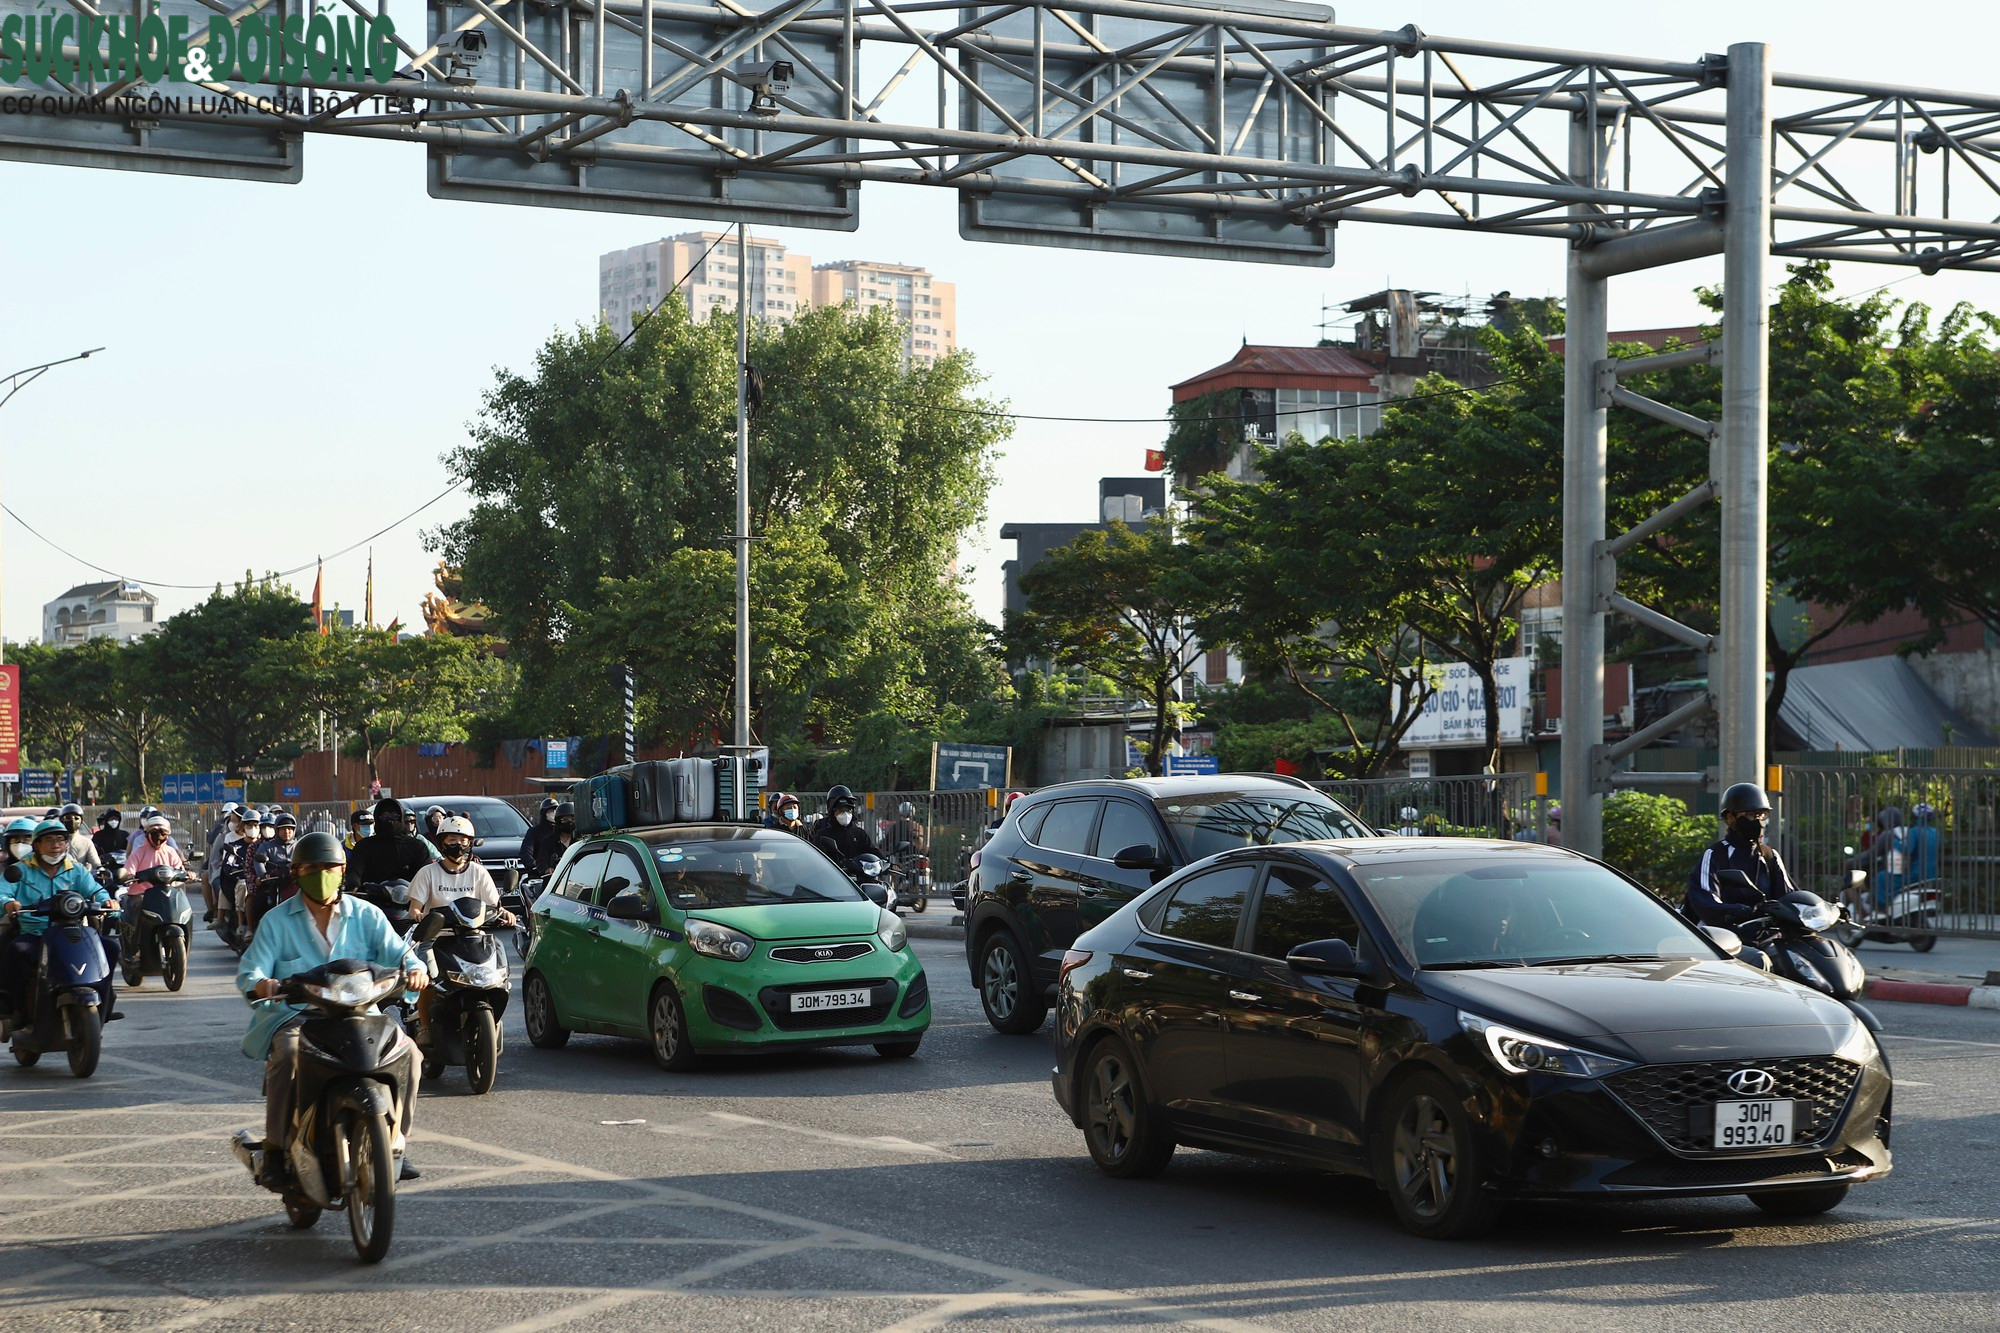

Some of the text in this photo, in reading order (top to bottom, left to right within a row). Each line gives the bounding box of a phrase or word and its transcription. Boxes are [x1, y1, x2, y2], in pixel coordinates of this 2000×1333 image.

[1449, 666, 1466, 679] SÓC
[1441, 684, 1460, 713] GIÓ
[1443, 715, 1486, 731] BẤM HUYỆ
[797, 993, 865, 1009] 30M-799.34
[1738, 1103, 1772, 1123] 30H
[1723, 1124, 1785, 1146] 993.40
